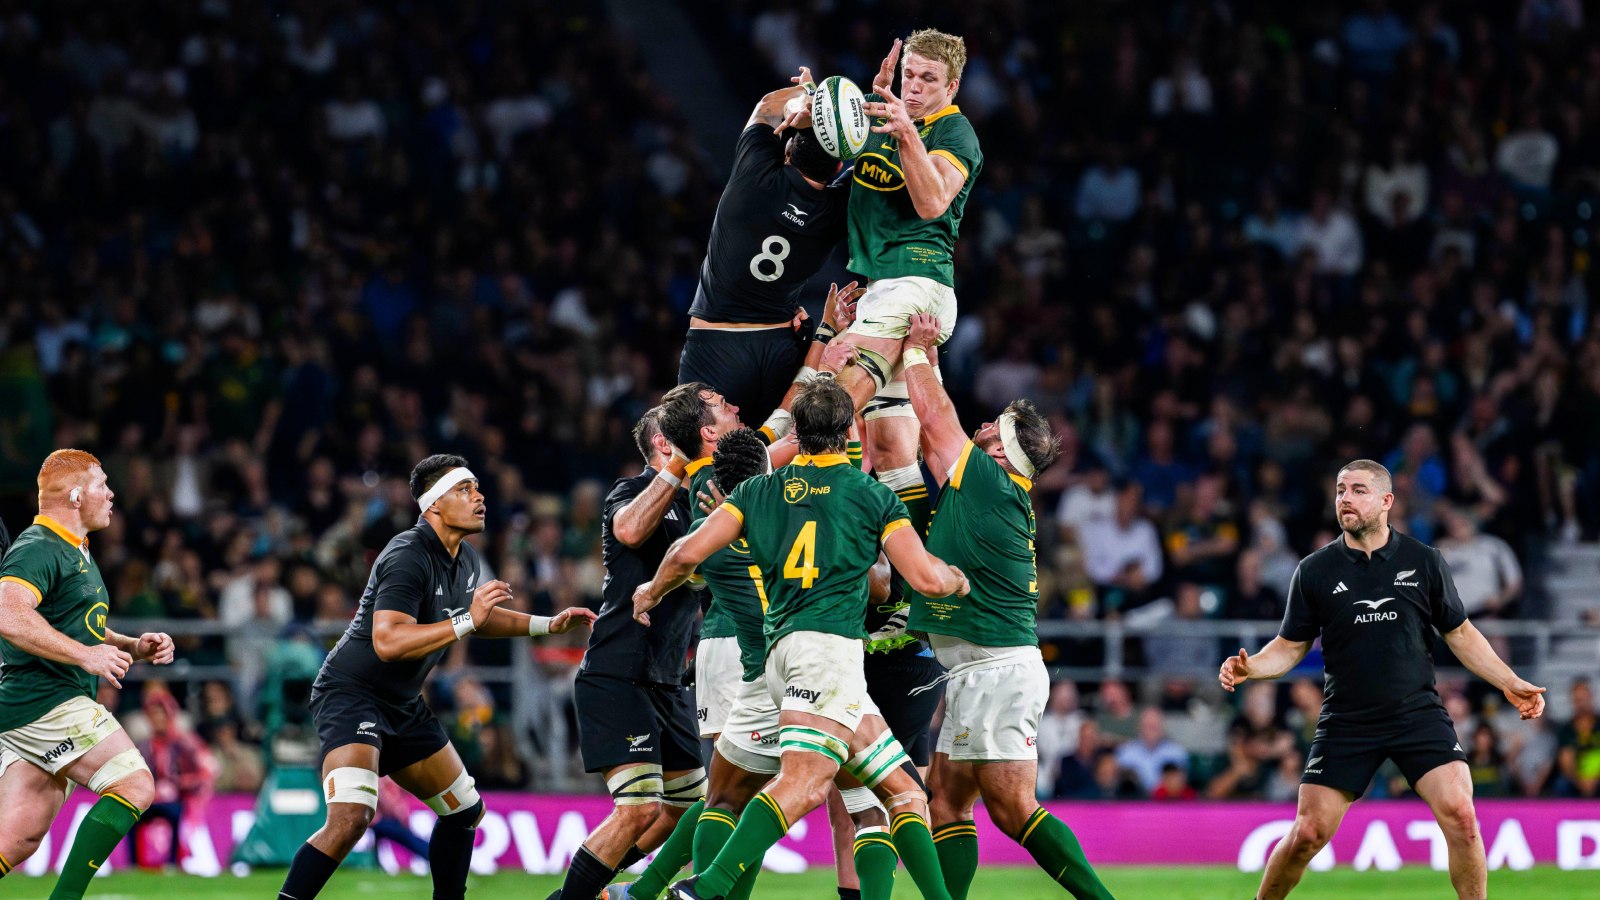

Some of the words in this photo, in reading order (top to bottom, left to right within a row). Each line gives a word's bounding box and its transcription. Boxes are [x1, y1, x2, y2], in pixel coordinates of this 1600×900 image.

[815, 88, 835, 152] GILBERT
[861, 161, 893, 183] MTN
[781, 210, 805, 227] ALTRAD
[749, 235, 791, 282] 8
[810, 486, 831, 495] FNB
[783, 521, 820, 589] 4
[1353, 611, 1398, 625] ALTRAD
